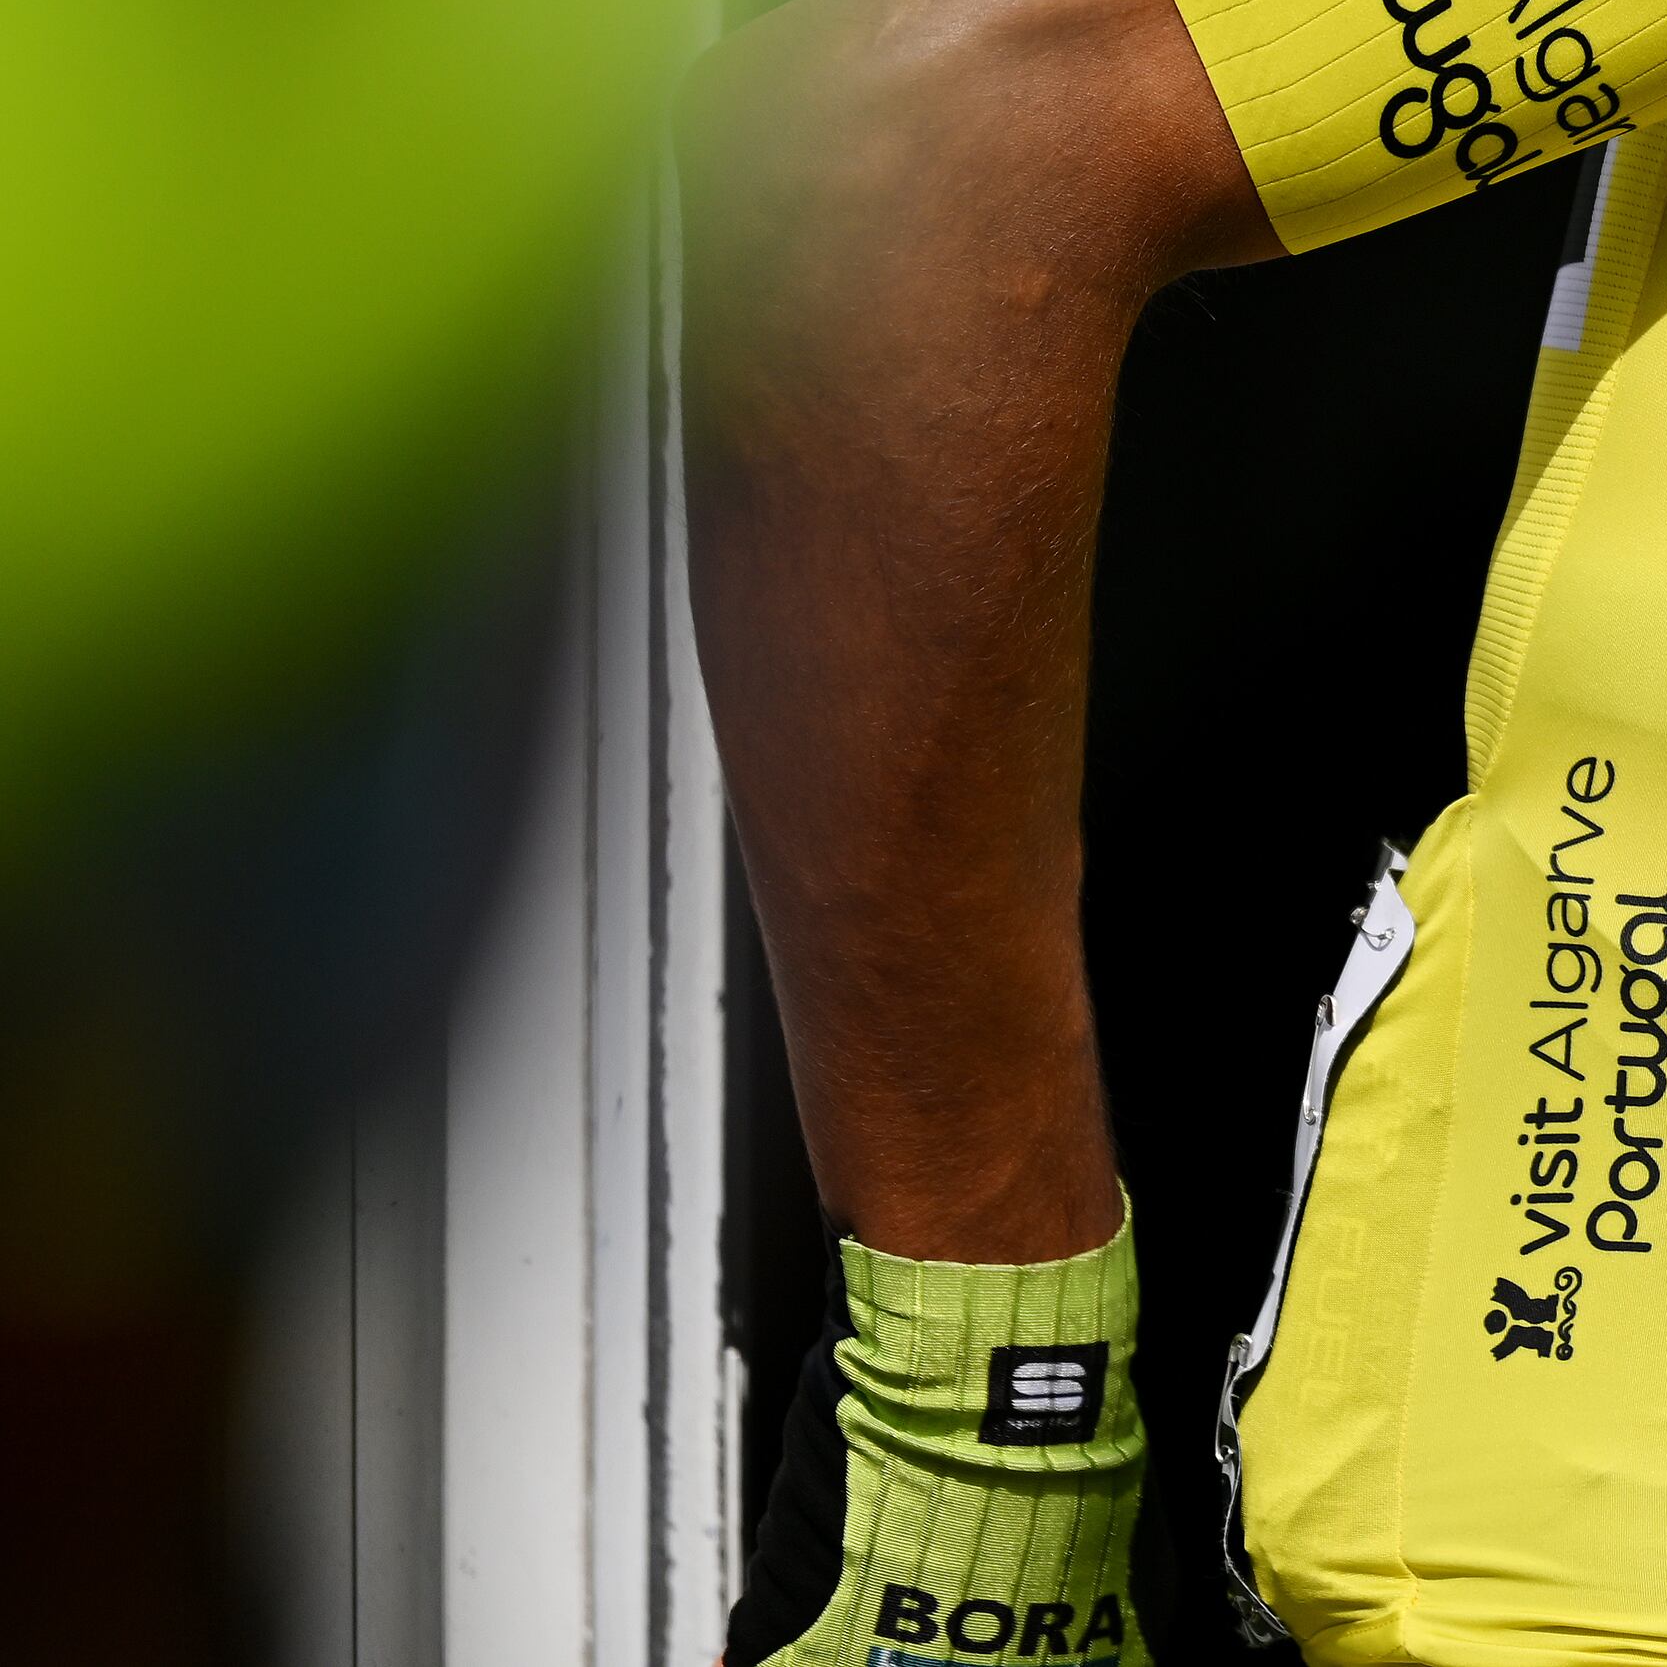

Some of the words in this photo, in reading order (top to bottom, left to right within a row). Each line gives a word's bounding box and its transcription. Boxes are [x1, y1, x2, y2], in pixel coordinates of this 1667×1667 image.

[1528, 755, 1616, 1083] Algarve
[1509, 1095, 1585, 1257] visit
[874, 1581, 1125, 1657] BORA
